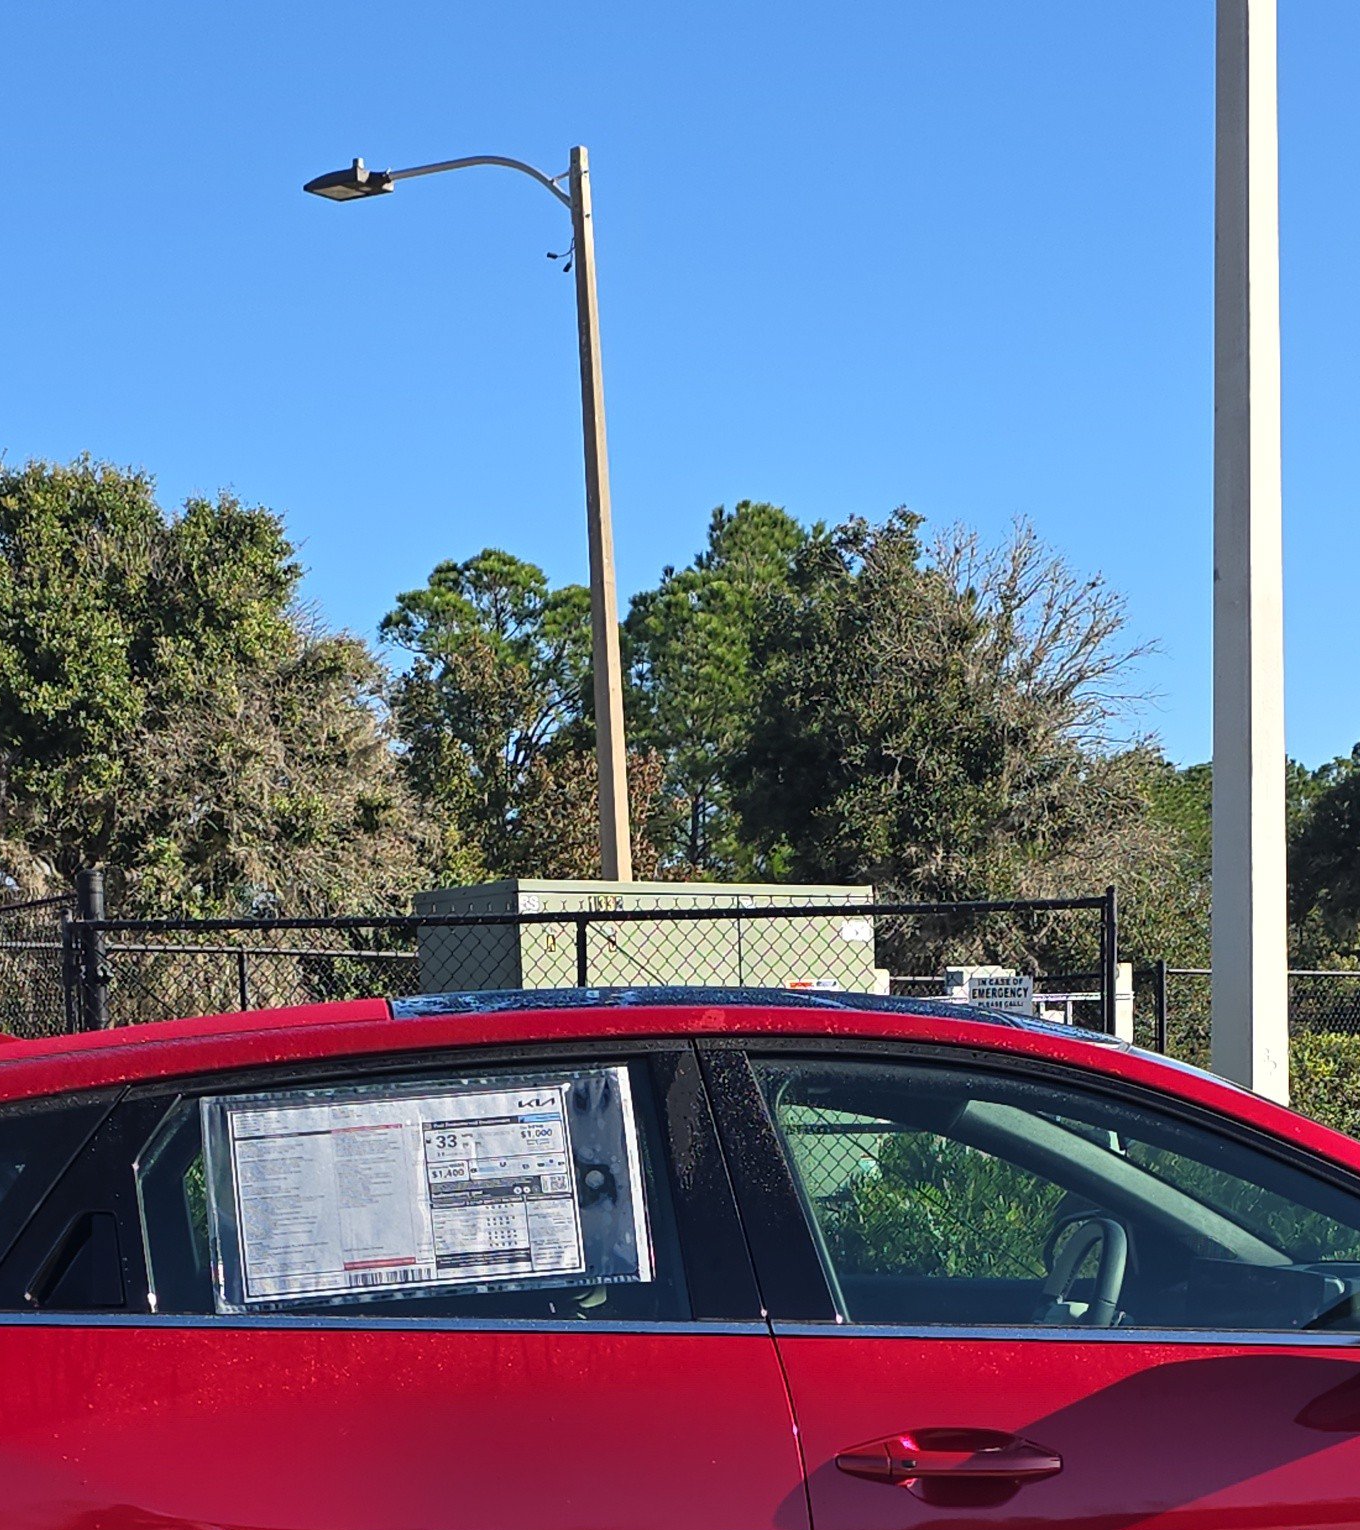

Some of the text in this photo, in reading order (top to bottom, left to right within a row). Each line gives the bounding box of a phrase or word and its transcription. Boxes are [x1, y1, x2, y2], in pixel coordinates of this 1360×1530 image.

[989, 977, 1010, 986] CASE
[1013, 977, 1023, 985] OF
[972, 987, 1029, 999] EMERGENCY
[436, 1134, 458, 1149] 33
